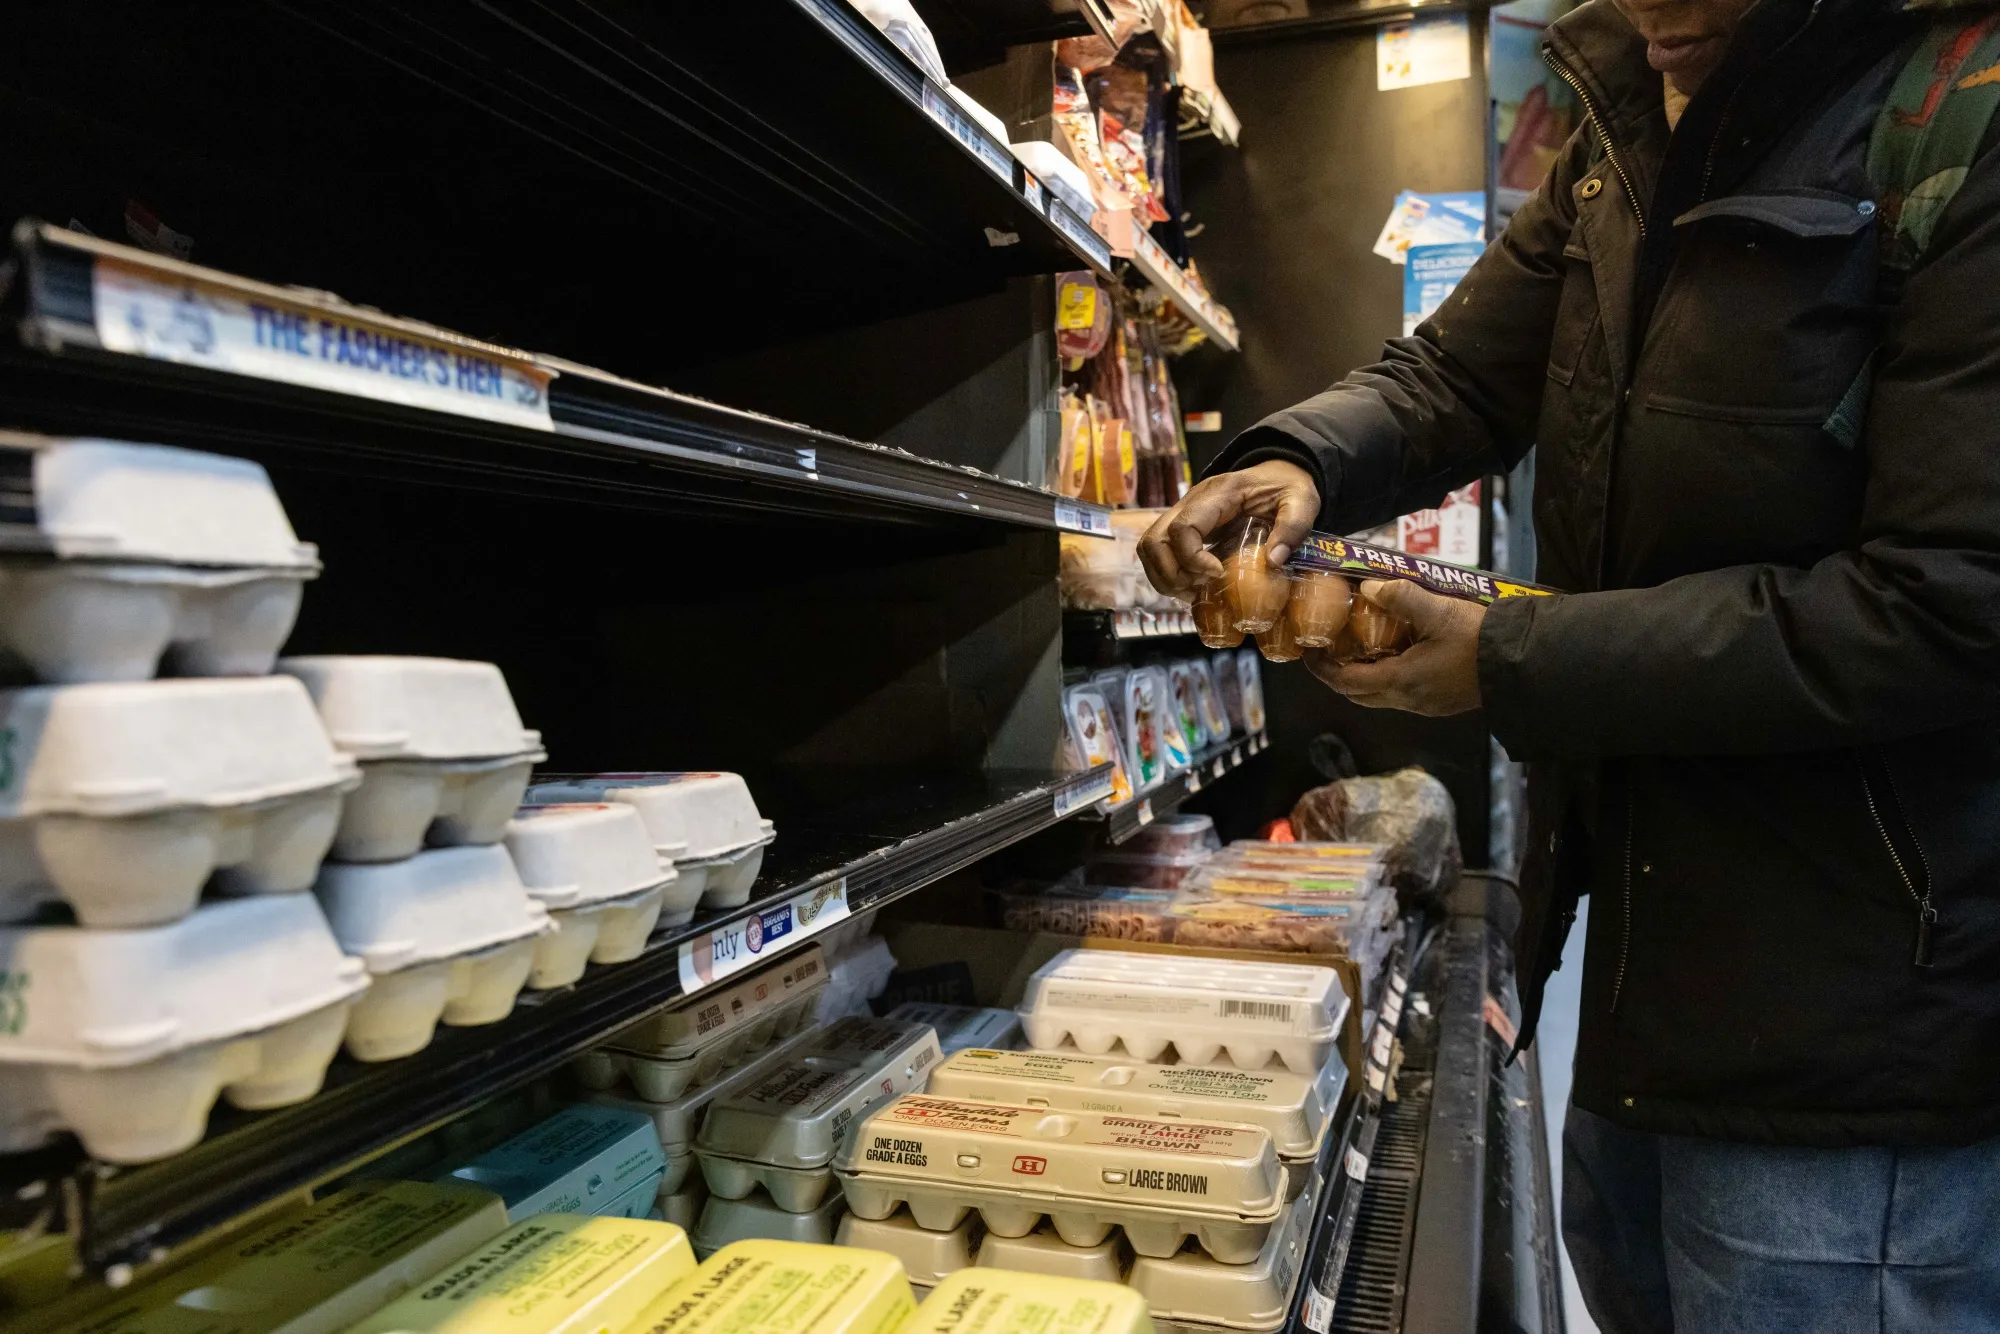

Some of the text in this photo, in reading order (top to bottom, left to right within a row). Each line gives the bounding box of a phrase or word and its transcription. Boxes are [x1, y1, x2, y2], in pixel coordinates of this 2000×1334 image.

[250, 302, 309, 357] THE
[318, 320, 451, 385] FARMER'S
[456, 353, 503, 400] HEN
[1351, 545, 1408, 569] FREE
[1415, 559, 1492, 595] RANGE
[763, 908, 790, 929] EGGLAND'S
[771, 922, 784, 936] BEST
[1008, 1053, 1059, 1062] Sunshine
[1061, 1057, 1095, 1065] Farms
[1024, 1062, 1064, 1070] EGGS
[1159, 1069, 1274, 1083] MEDIUM BROWN
[1187, 1068, 1233, 1076] GRADE
[1149, 1083, 1178, 1091] One
[1182, 1086, 1228, 1095] Dozen
[1233, 1090, 1268, 1099] Eggs
[899, 1099, 1019, 1118] Hillandale
[1081, 1102, 1090, 1110] 12
[1091, 1104, 1115, 1112] GRADE
[831, 1107, 852, 1130] ONE DOZEN
[894, 1114, 921, 1122] ONE
[924, 1118, 968, 1128] DOZEN
[971, 1122, 1008, 1132] EGGS
[939, 1112, 1011, 1126] Farms
[831, 1127, 845, 1144] GRADE
[1102, 1119, 1153, 1131] GRADE
[1188, 1126, 1234, 1137] EGGS
[1139, 1129, 1206, 1140] LARGE
[874, 1136, 922, 1154] ONE DOZEN
[1115, 1136, 1201, 1150] BROWN
[866, 1149, 928, 1167] GRADE A EGGS
[1020, 1159, 1039, 1172] H
[1129, 1168, 1208, 1195] LARGE BROWN
[421, 1263, 485, 1300] GRADE
[489, 1227, 547, 1255] LARGE
[703, 1256, 752, 1291] LARGE
[941, 1286, 985, 1326] LARGE
